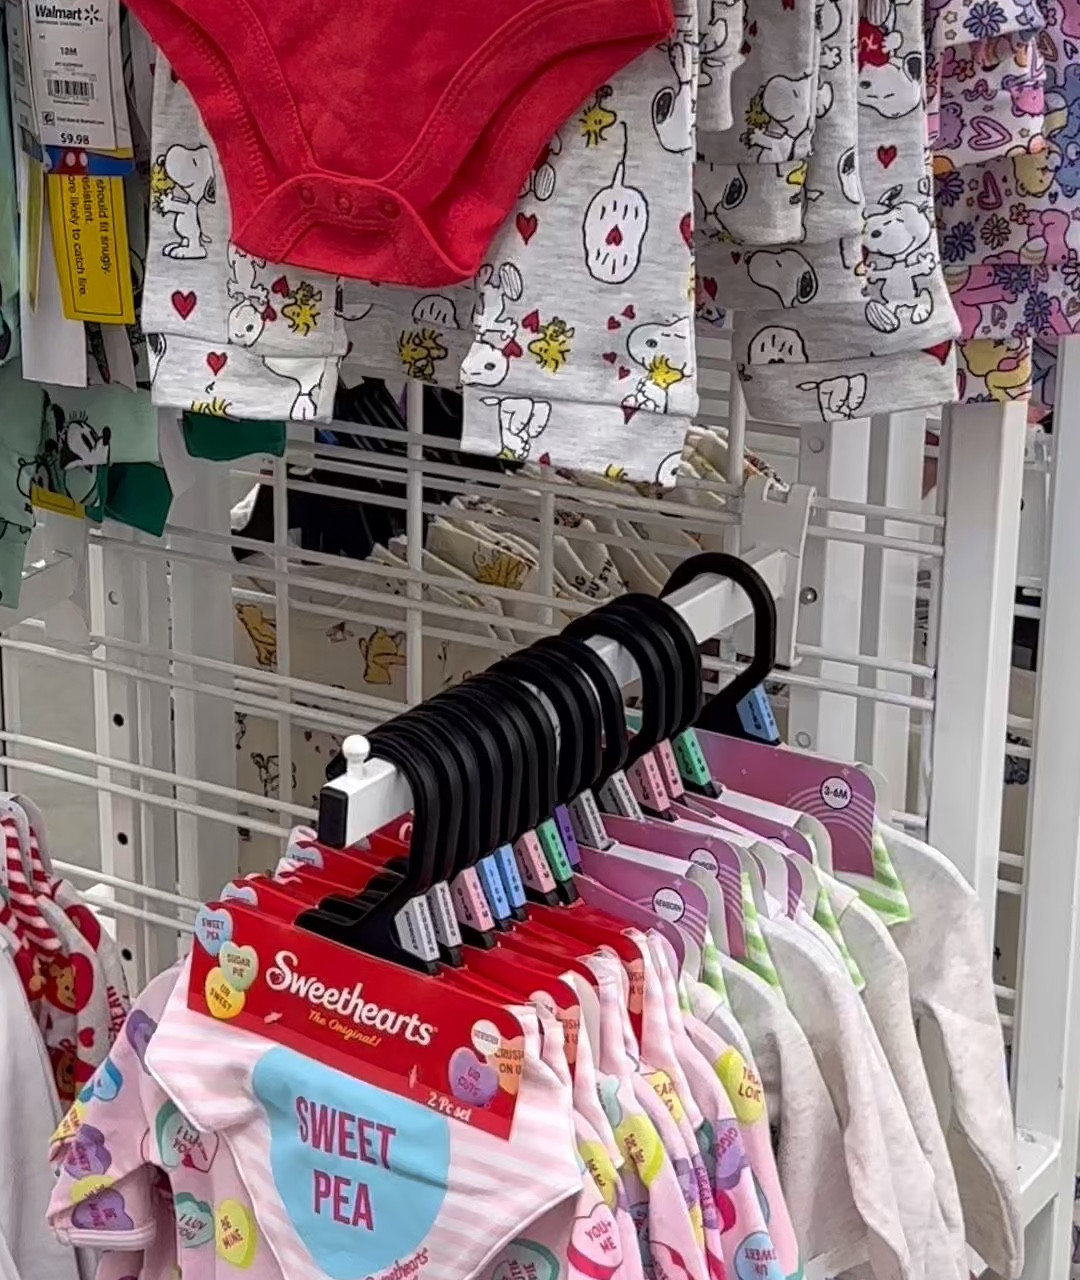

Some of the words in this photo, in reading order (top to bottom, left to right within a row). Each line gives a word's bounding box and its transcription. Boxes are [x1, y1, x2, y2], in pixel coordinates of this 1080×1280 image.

[35, 4, 83, 21] Walmart
[60, 132, 90, 145] $9.98
[66, 175, 78, 196] ore
[82, 176, 96, 225] esistant.
[96, 179, 110, 221] should
[69, 197, 82, 228] likely
[72, 228, 81, 241] to
[98, 221, 110, 236] fit
[75, 242, 86, 276] catch
[823, 784, 849, 801] 3-6M
[265, 949, 433, 1047] Sweethearts
[307, 1008, 327, 1031] The
[499, 1063, 514, 1075] ON
[427, 1090, 438, 1108] 2
[454, 1104, 472, 1122] set
[294, 1094, 397, 1170] SWEET
[312, 1168, 375, 1232] PEA
[600, 1237, 618, 1255] ME
